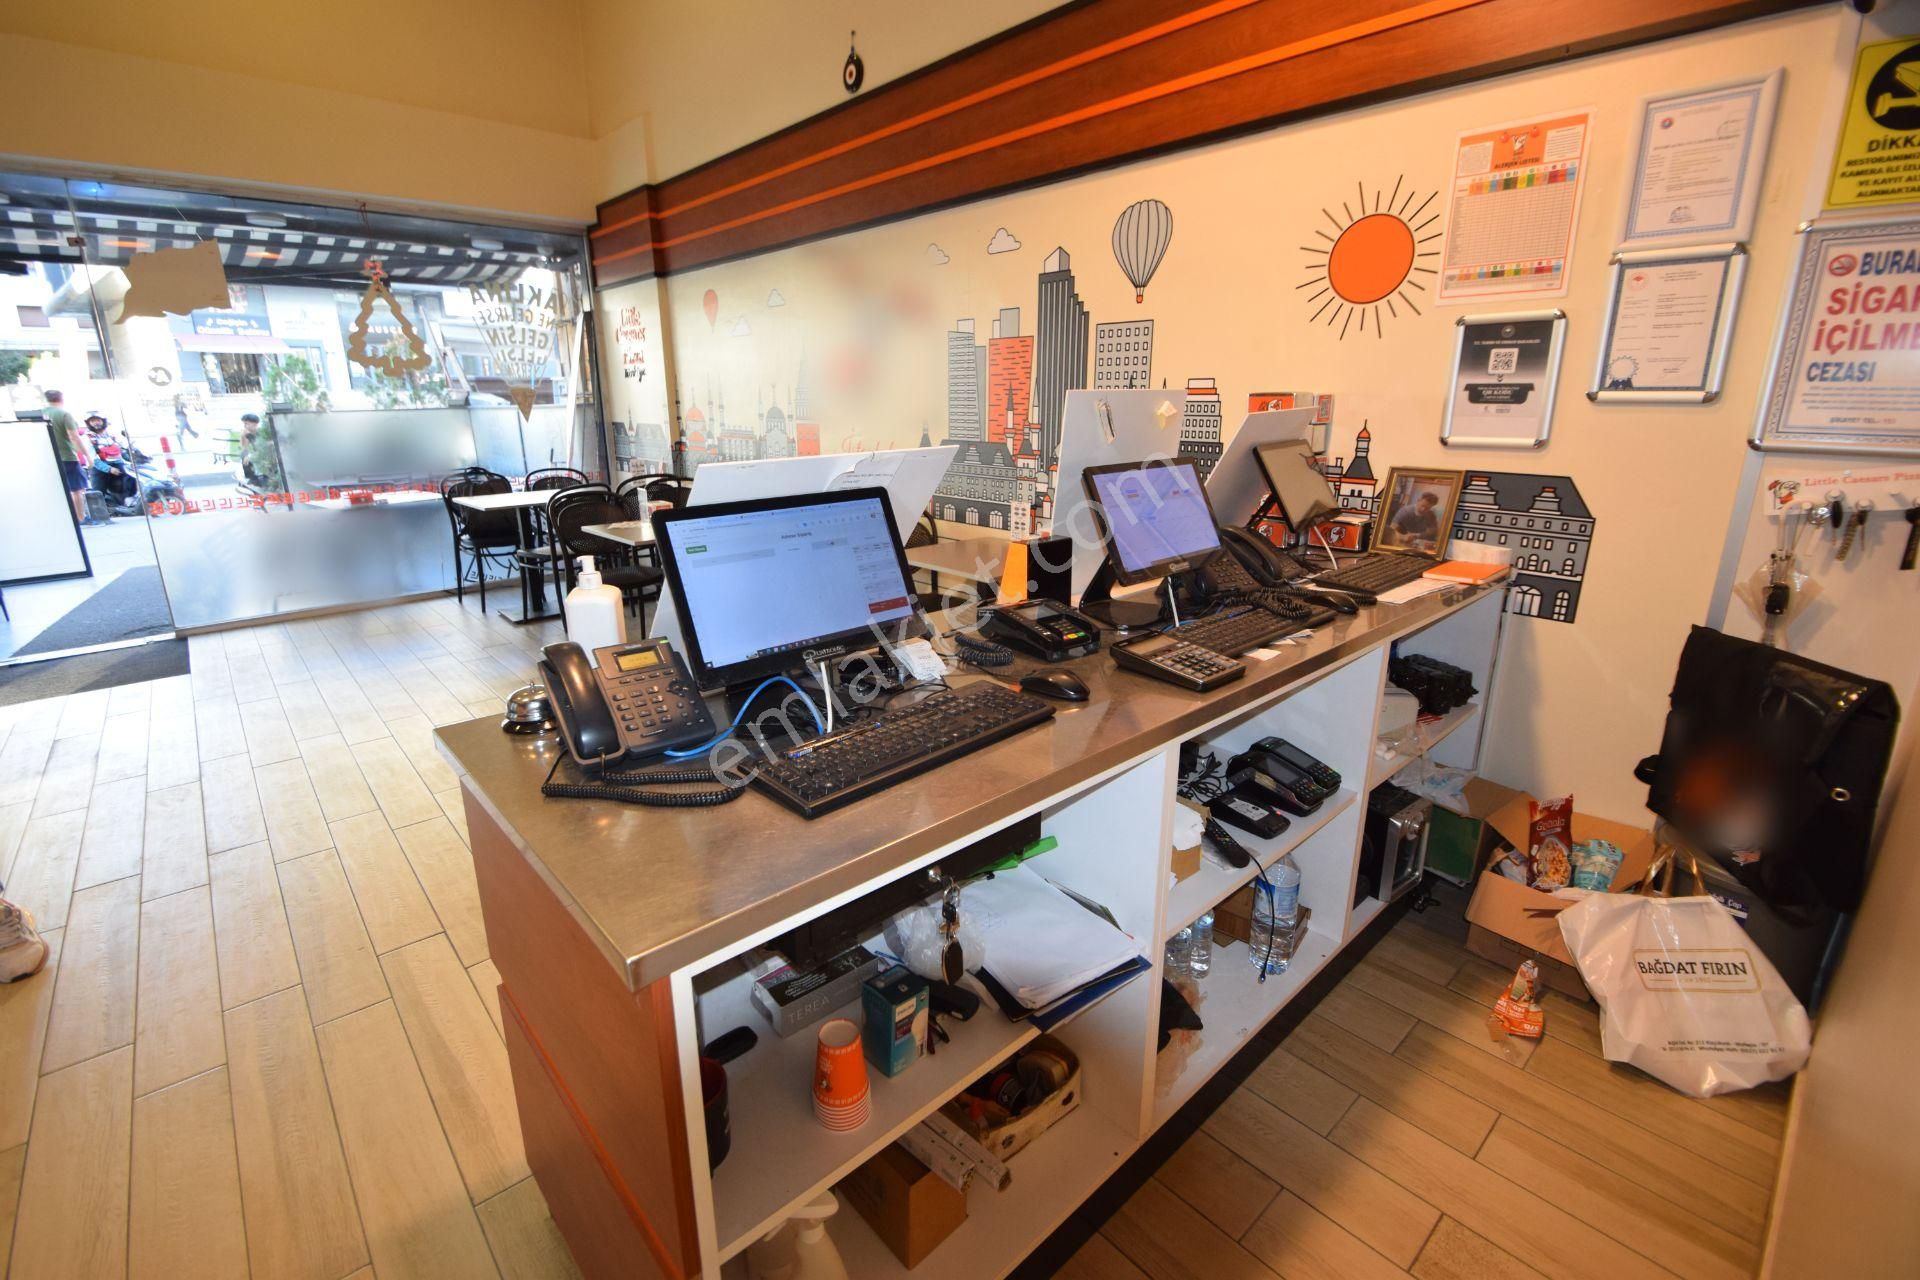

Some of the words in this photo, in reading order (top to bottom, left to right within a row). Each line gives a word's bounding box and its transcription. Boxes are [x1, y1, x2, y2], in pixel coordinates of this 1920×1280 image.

[1858, 249, 1920, 276] BURA
[1806, 361, 1877, 382] CEZASI
[1804, 477, 1838, 487] Little
[1637, 958, 1697, 975] BAĞDAT
[1700, 961, 1748, 976] FIRIN
[788, 995, 831, 1025] TEREA
